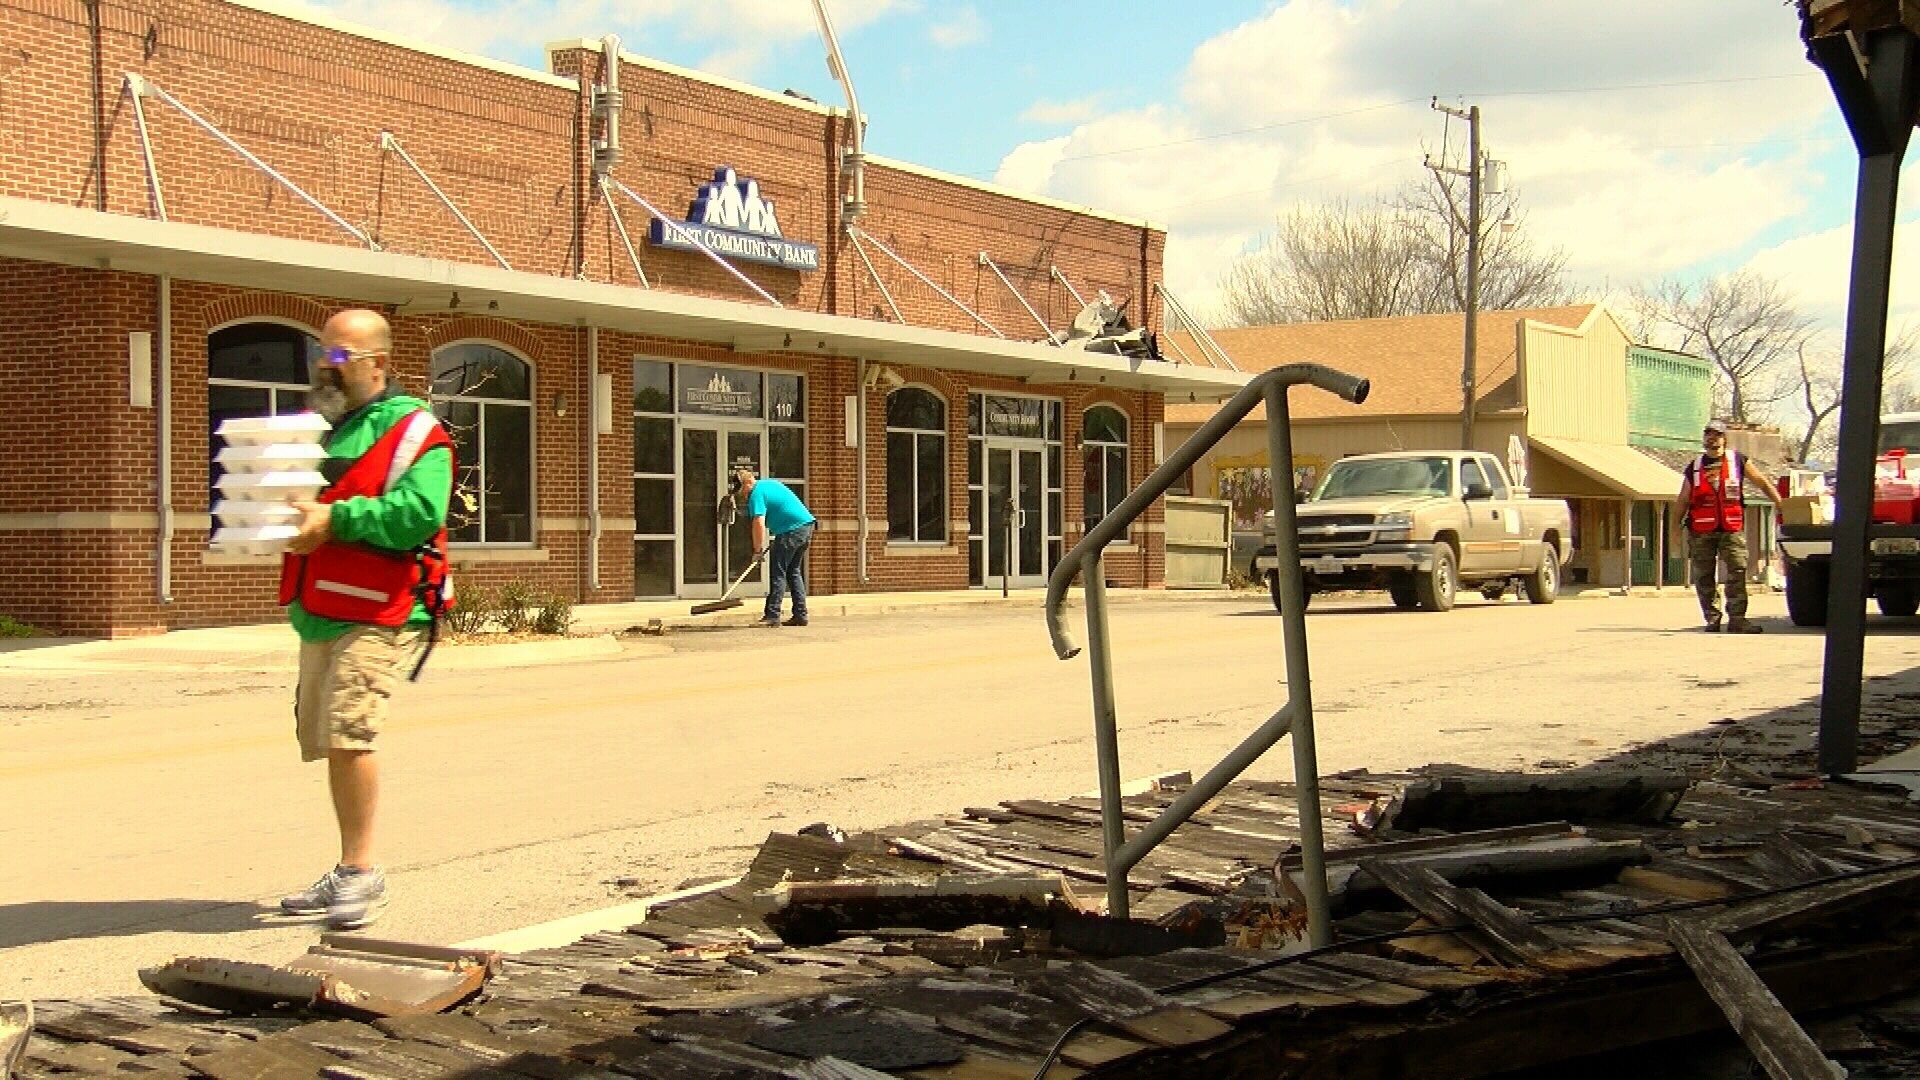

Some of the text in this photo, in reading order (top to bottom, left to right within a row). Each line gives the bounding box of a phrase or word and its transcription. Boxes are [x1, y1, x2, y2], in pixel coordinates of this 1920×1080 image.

[705, 230, 781, 258] COMMUNITY
[784, 244, 817, 266] BANK
[776, 403, 792, 417] 110
